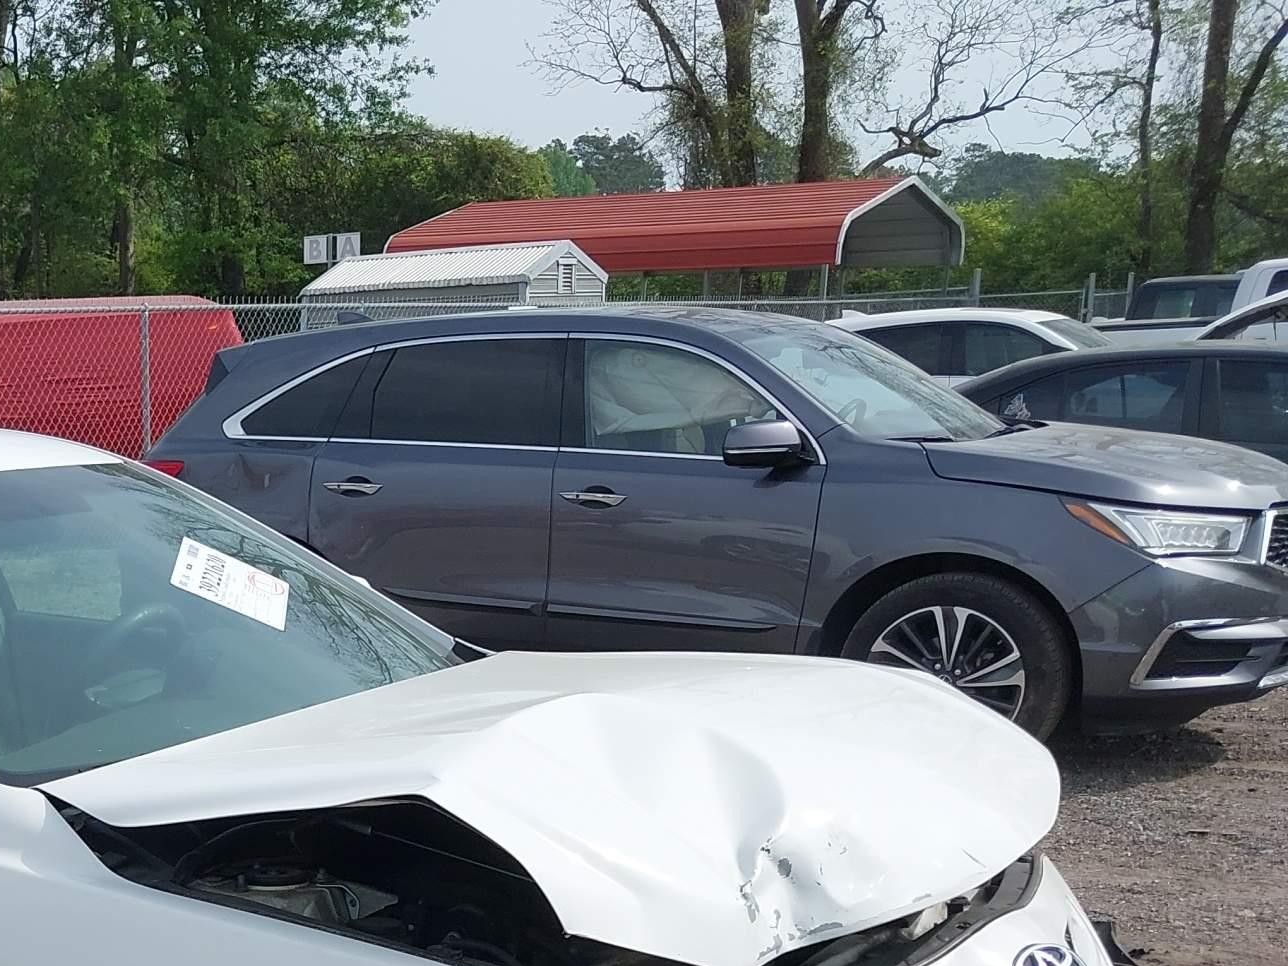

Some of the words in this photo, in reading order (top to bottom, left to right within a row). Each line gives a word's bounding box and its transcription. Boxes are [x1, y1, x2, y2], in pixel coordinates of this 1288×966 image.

[309, 239, 322, 260] B
[340, 237, 357, 259] A
[198, 553, 227, 597] 39221620
